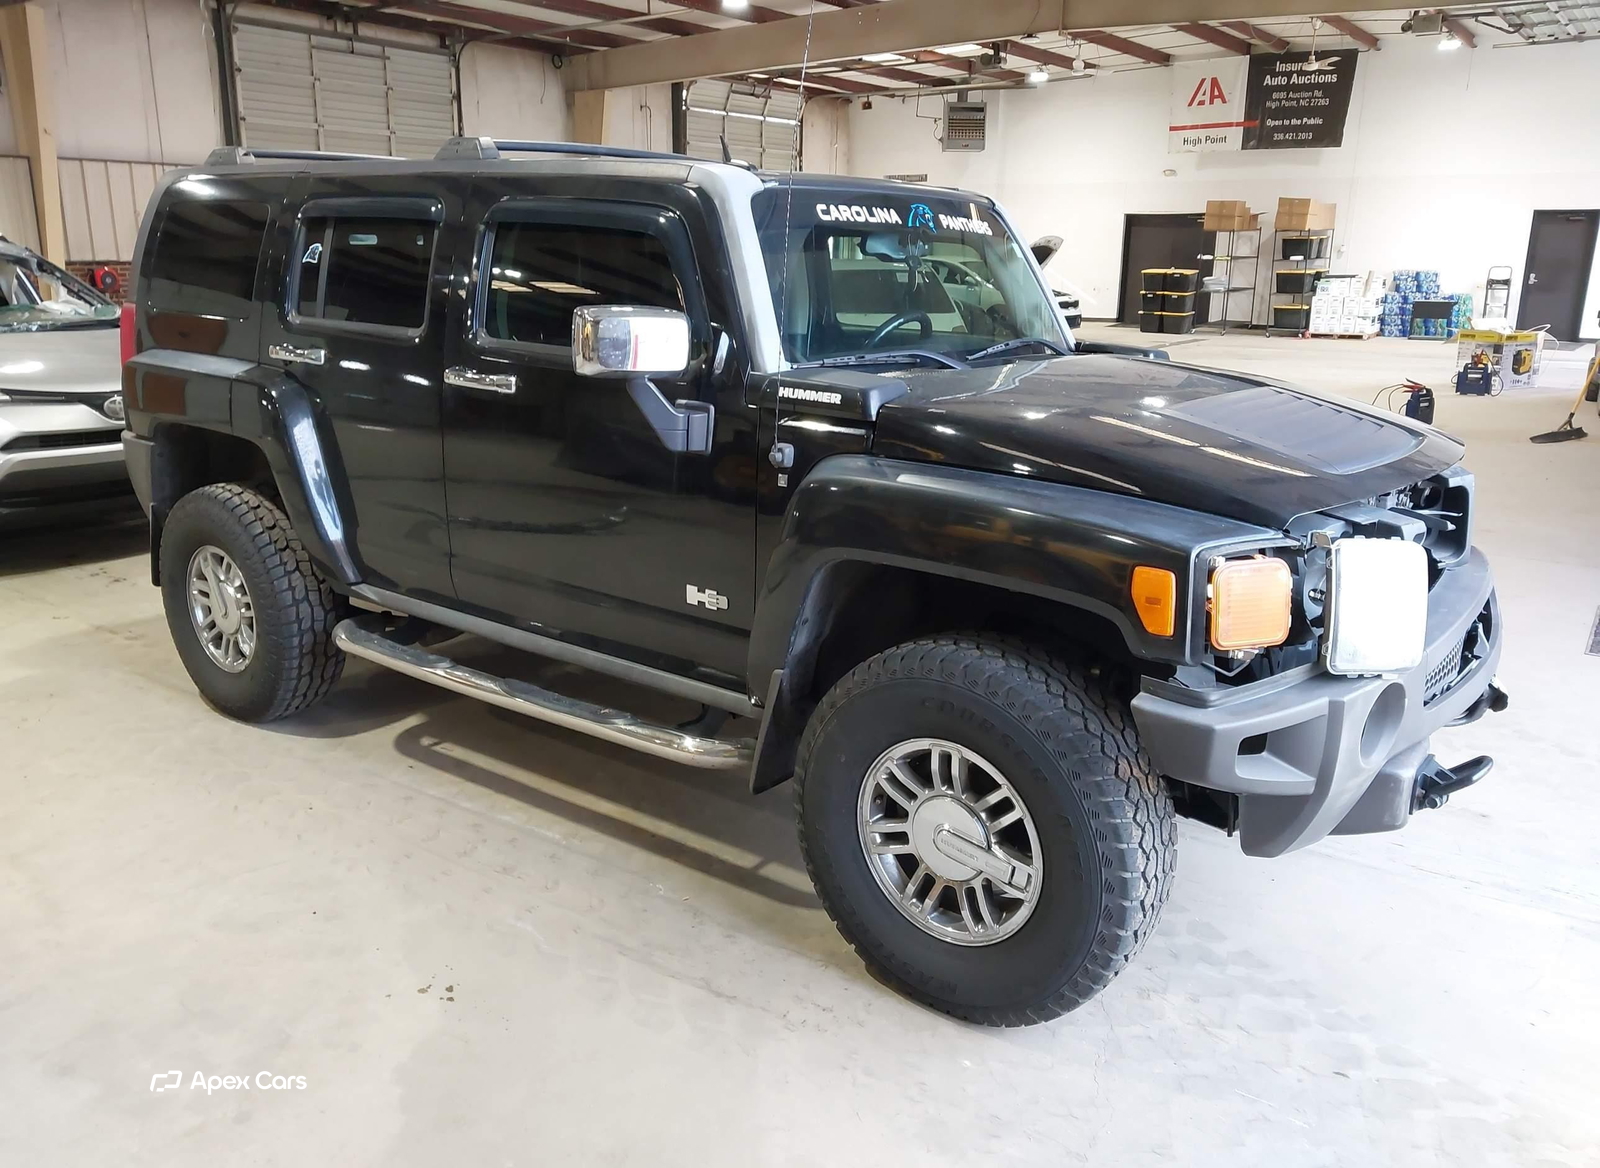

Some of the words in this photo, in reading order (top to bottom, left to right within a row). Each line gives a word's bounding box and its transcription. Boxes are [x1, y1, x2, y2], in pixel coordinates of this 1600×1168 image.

[1263, 74, 1288, 86] Auto
[1290, 72, 1338, 84] Auctions
[1288, 90, 1312, 98] Auction
[1265, 100, 1279, 109] High
[1281, 99, 1298, 107] Point,
[1266, 118, 1282, 127] Open
[1291, 117, 1301, 125] the
[1302, 117, 1324, 125] Public
[1183, 136, 1202, 147] High
[1205, 135, 1227, 144] Point
[816, 203, 902, 225] CAROLINA
[779, 387, 842, 404] HUMMER
[686, 584, 728, 610] H3
